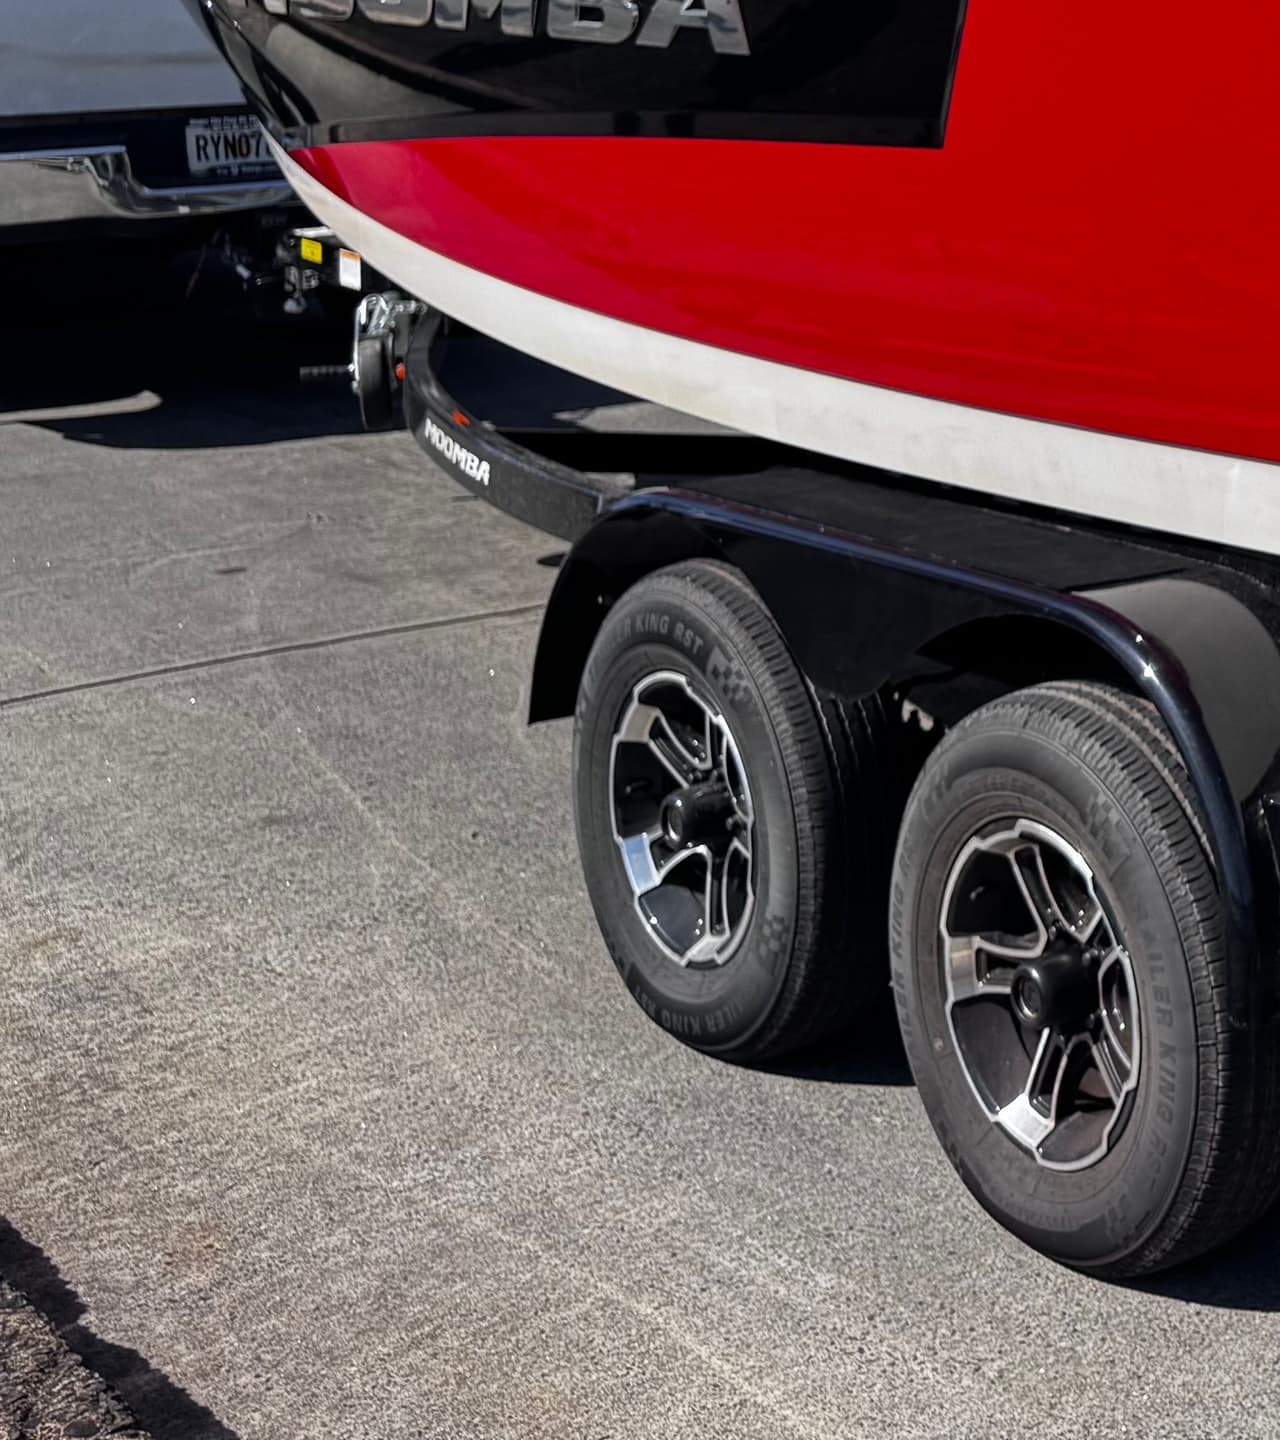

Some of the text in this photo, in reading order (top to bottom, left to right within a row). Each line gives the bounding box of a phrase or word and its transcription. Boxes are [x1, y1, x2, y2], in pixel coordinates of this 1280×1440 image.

[424, 417, 490, 486] MOOMBA
[635, 612, 705, 655] KING RST
